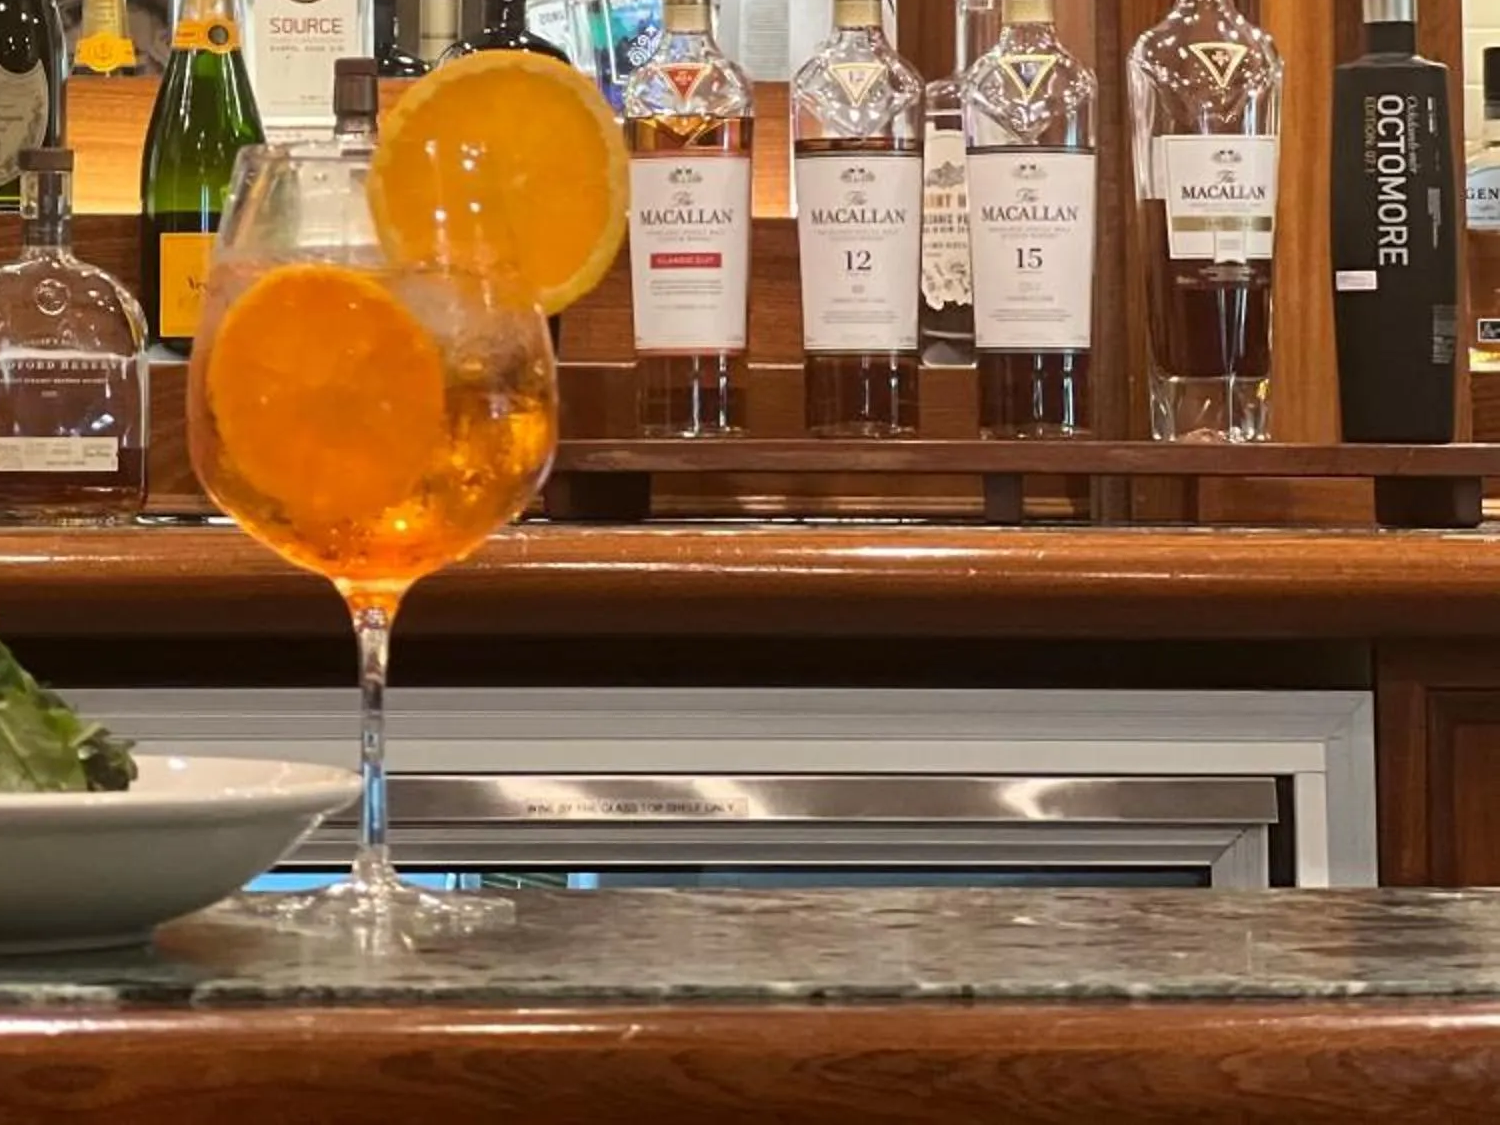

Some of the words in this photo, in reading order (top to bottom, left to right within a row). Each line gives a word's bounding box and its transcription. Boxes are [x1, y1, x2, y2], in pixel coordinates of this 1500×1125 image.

[270, 17, 344, 34] SOURCE
[1377, 94, 1409, 266] OCTOMORE
[1181, 185, 1266, 200] MACALLAN
[640, 208, 734, 226] MACALLAN
[811, 208, 908, 225] MACALLAN
[981, 206, 1079, 222] MACALLAN
[845, 250, 872, 271] 12
[1016, 248, 1044, 269] 15
